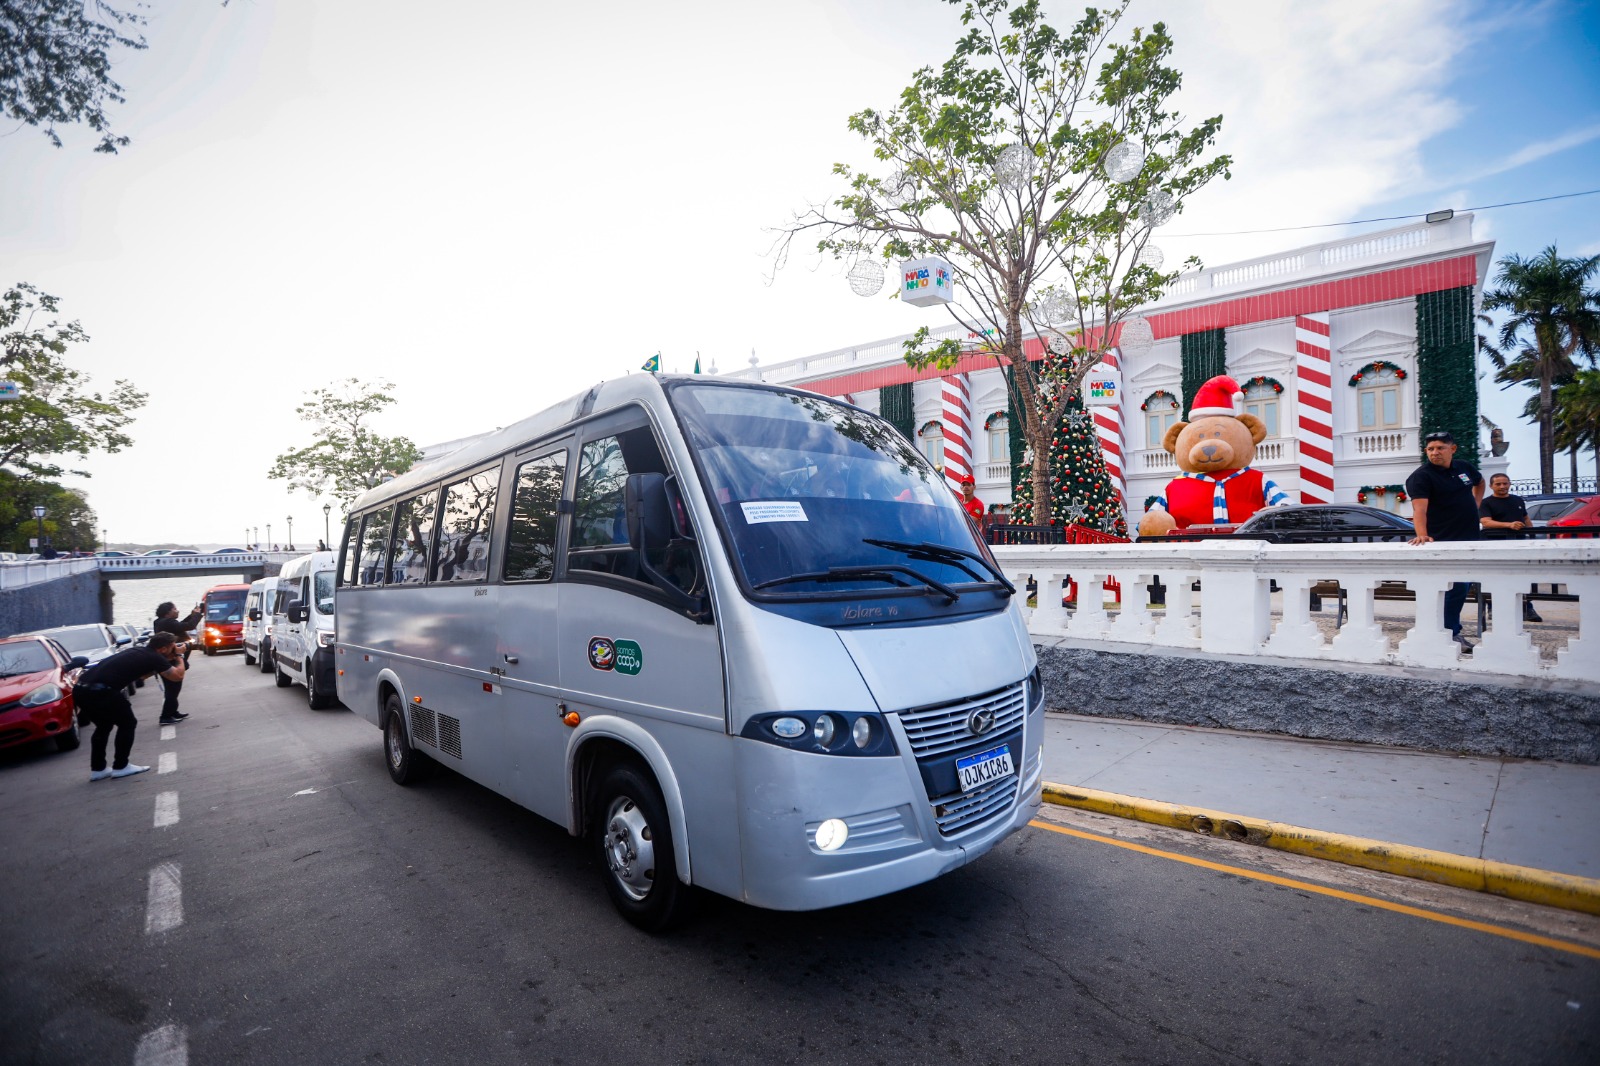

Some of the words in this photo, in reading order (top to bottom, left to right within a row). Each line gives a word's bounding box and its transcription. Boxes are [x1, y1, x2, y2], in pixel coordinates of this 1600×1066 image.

[905, 269, 929, 281] MARA
[841, 604, 882, 619] Volare
[616, 647, 635, 656] somos
[964, 756, 1009, 786] OJK1C86
